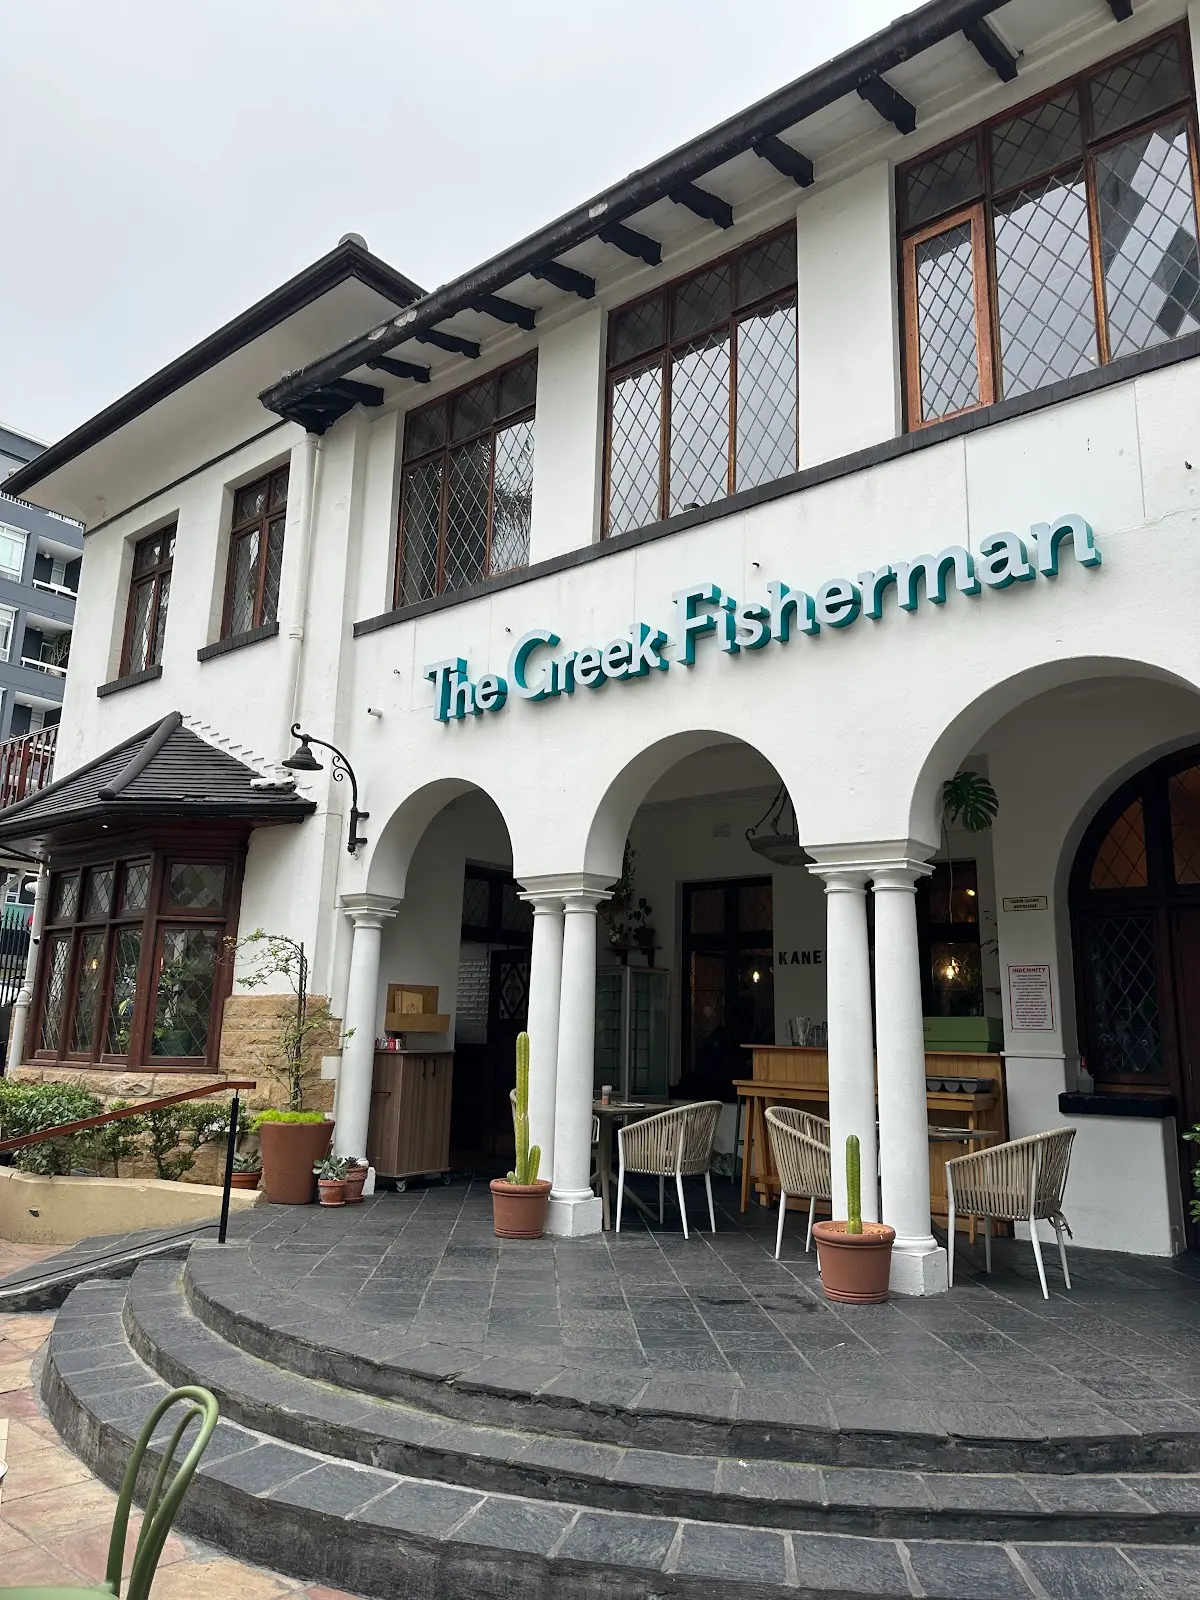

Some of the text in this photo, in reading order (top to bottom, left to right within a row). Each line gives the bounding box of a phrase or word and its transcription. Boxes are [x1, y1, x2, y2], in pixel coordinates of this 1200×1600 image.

[424, 513, 1102, 722] The Greek Fisherman
[778, 950, 827, 965] KANE
